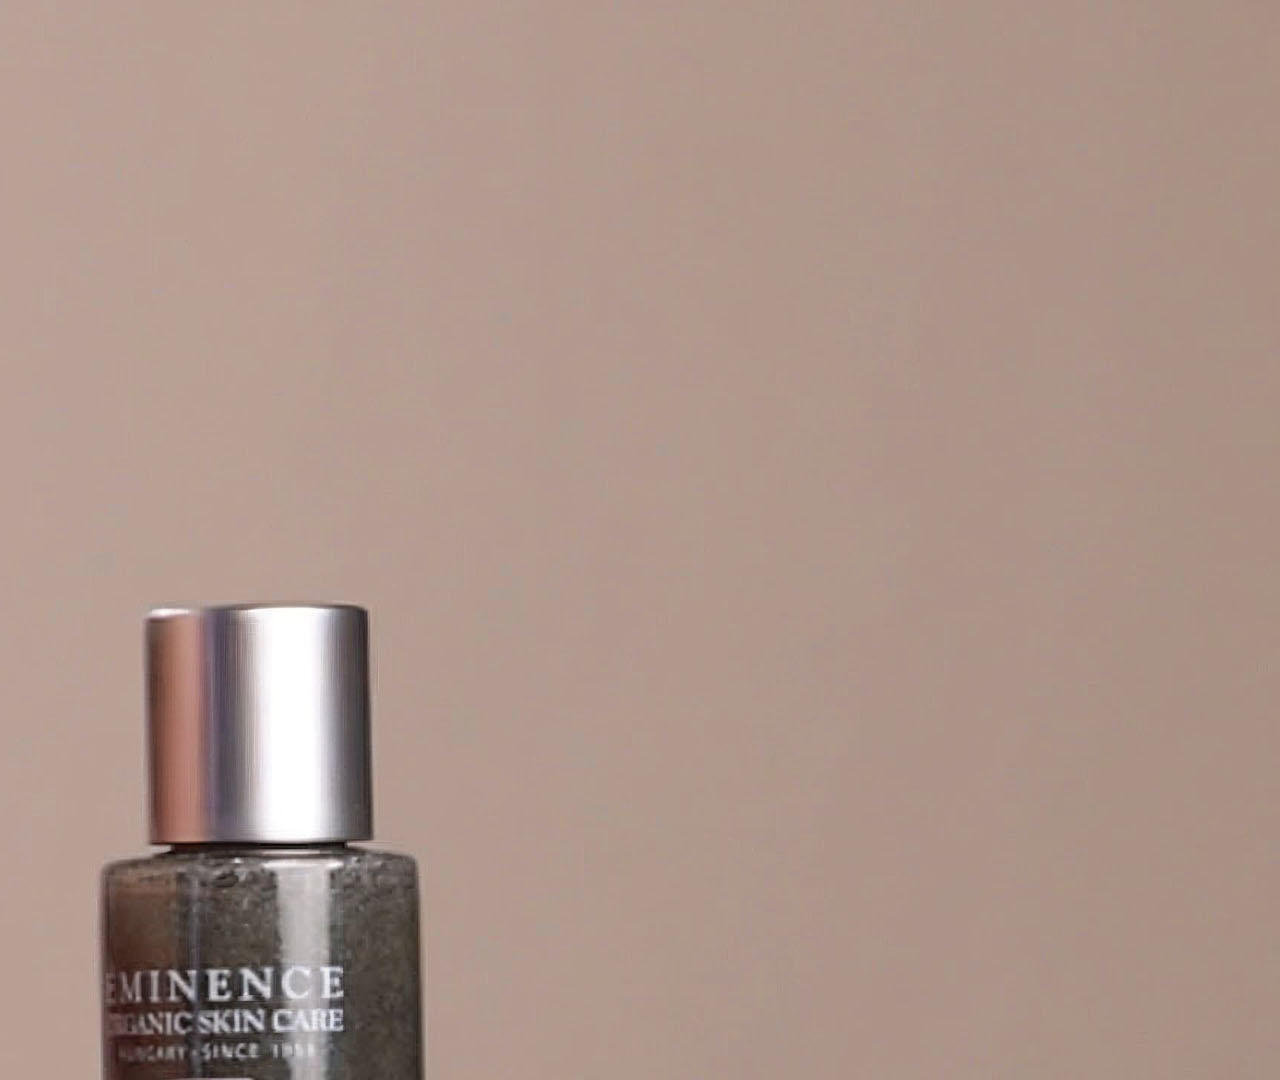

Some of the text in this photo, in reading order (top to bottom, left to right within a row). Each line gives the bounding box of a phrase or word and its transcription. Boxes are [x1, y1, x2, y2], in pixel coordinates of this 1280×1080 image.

[108, 1008, 344, 1036] RGANIC SKIN CARE
[200, 1042, 259, 1060] SINCE
